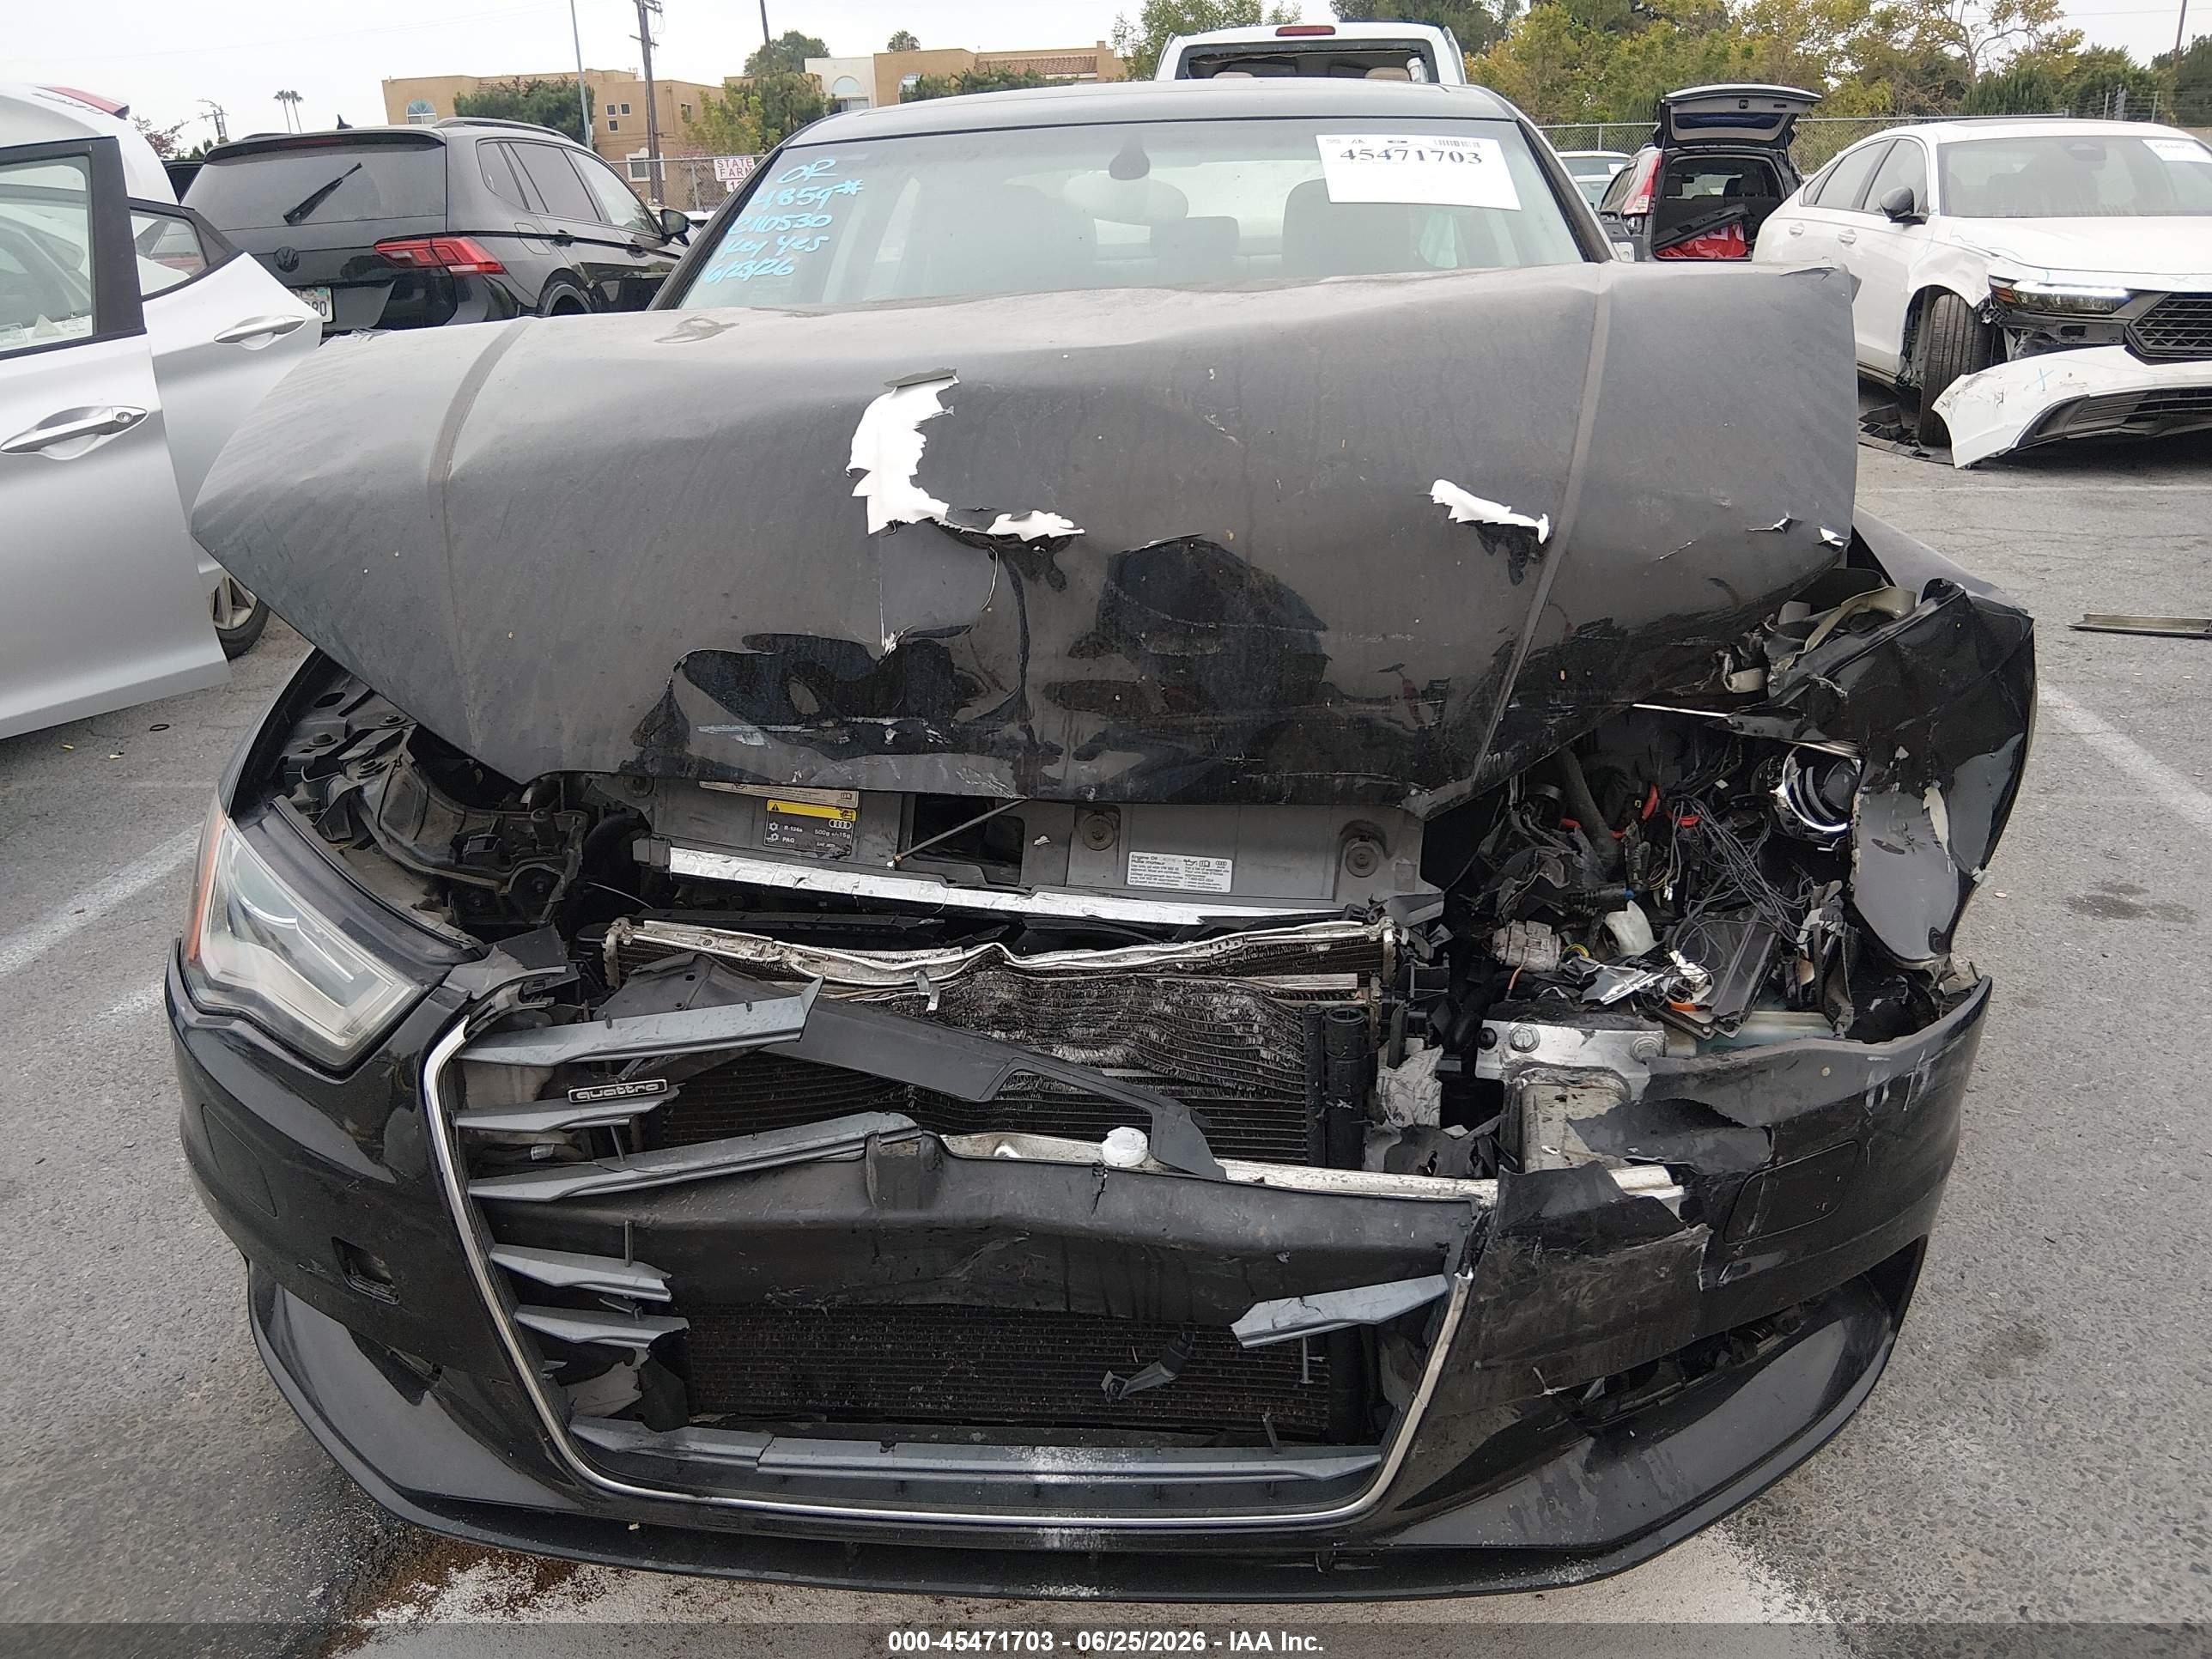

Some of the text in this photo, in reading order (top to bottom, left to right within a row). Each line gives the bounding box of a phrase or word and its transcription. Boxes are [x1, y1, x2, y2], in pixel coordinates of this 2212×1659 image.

[717, 158, 753, 168] STATE
[1340, 149, 1483, 165] 45471703
[720, 167, 752, 177] FARM
[575, 1083, 659, 1100] quattro
